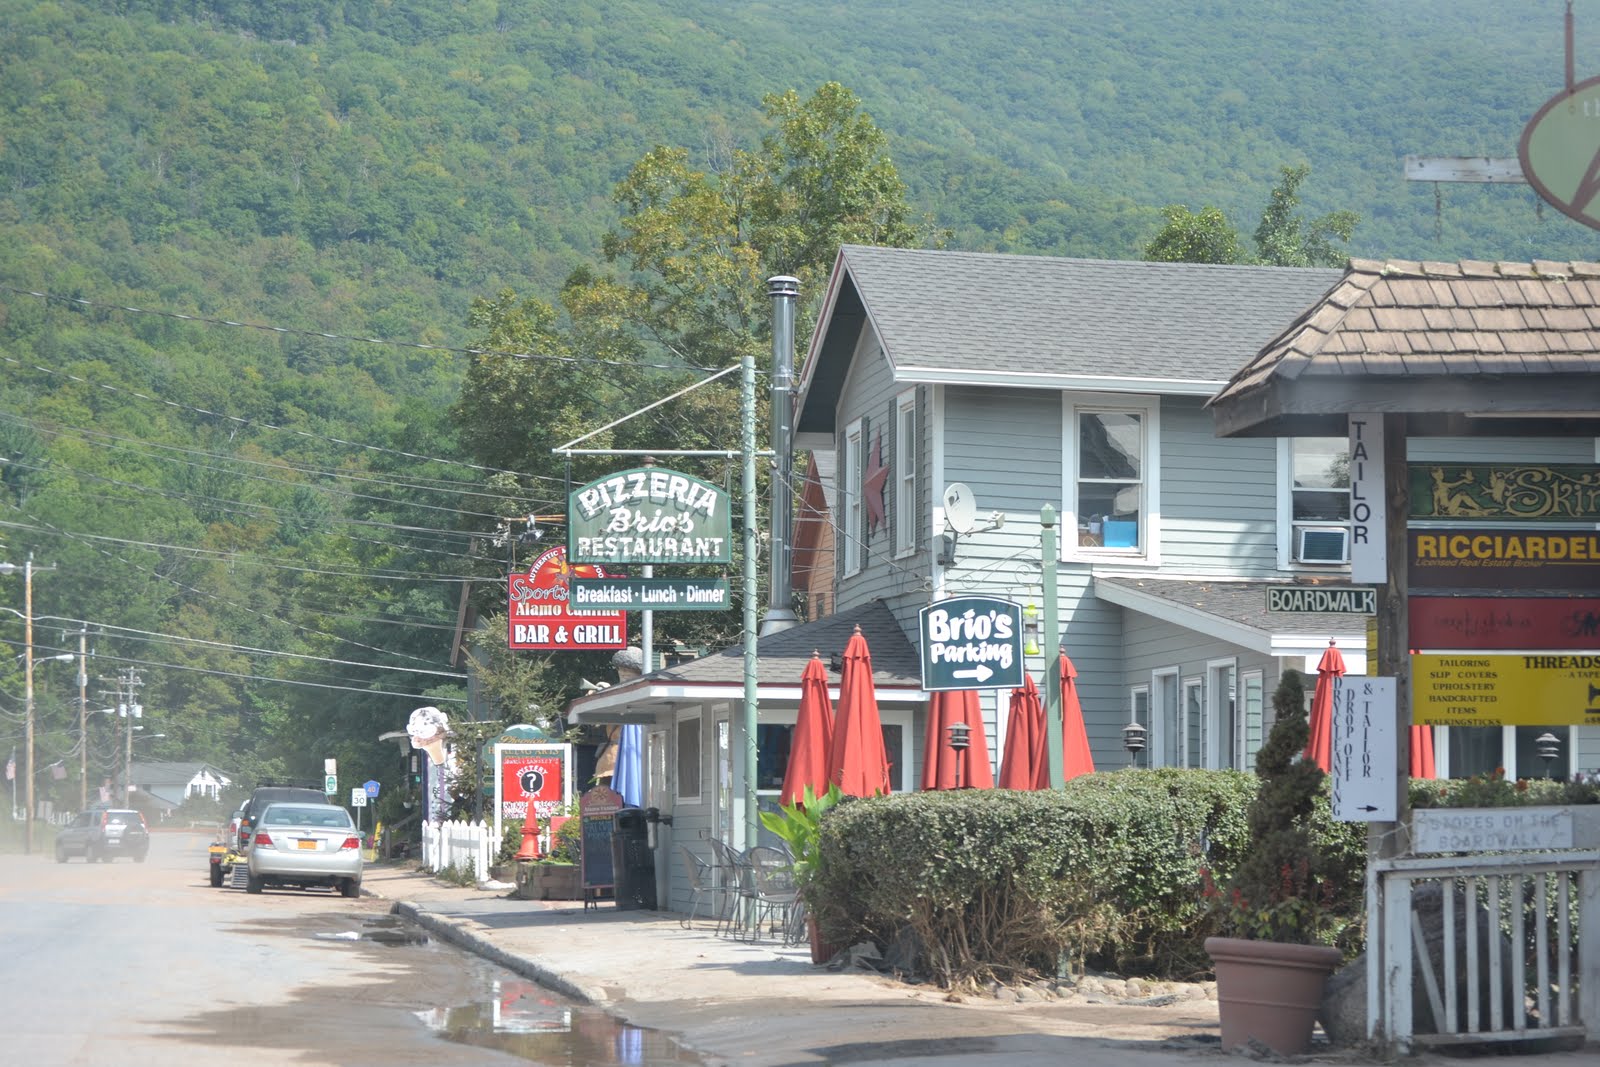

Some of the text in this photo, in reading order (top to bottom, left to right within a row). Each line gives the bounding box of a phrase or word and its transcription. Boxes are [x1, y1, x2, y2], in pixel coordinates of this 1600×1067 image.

[1351, 421, 1371, 544] TAILOR
[577, 471, 718, 517] PIZZERIA
[606, 505, 695, 534] Brio's
[577, 536, 724, 557] RESTAURANT
[1416, 535, 1600, 559] RICCIARDEL
[528, 550, 559, 584] AUTHENTIC
[1416, 559, 1544, 568] Licensed Real Estate Broker
[510, 578, 569, 606] Sports
[577, 585, 725, 603] Breakfast Lunch Dinner
[515, 602, 562, 616] Alamo
[1270, 590, 1375, 613] BOARDWALK
[514, 624, 622, 643] BAR & GRILL
[928, 608, 1013, 642] Brio's
[930, 641, 1013, 669] Parking
[1439, 659, 1490, 667] TAILORING
[1522, 656, 1600, 669] THREADS
[1430, 671, 1498, 679] SLIP COVERS
[1363, 682, 1373, 695] &
[1429, 695, 1498, 703] HANDCRAFTED
[1447, 706, 1477, 714] ITEMS
[1424, 718, 1502, 726] WALKINGSTICKS
[1344, 689, 1355, 781] DROP OFF
[1362, 701, 1372, 778] TAILOR
[1332, 677, 1342, 817] DRYCLEANING
[515, 764, 549, 778] MYSTERY
[353, 797, 365, 805] 30
[1431, 814, 1561, 831] STORES ON THE
[1438, 832, 1542, 850] BOARDWALK
